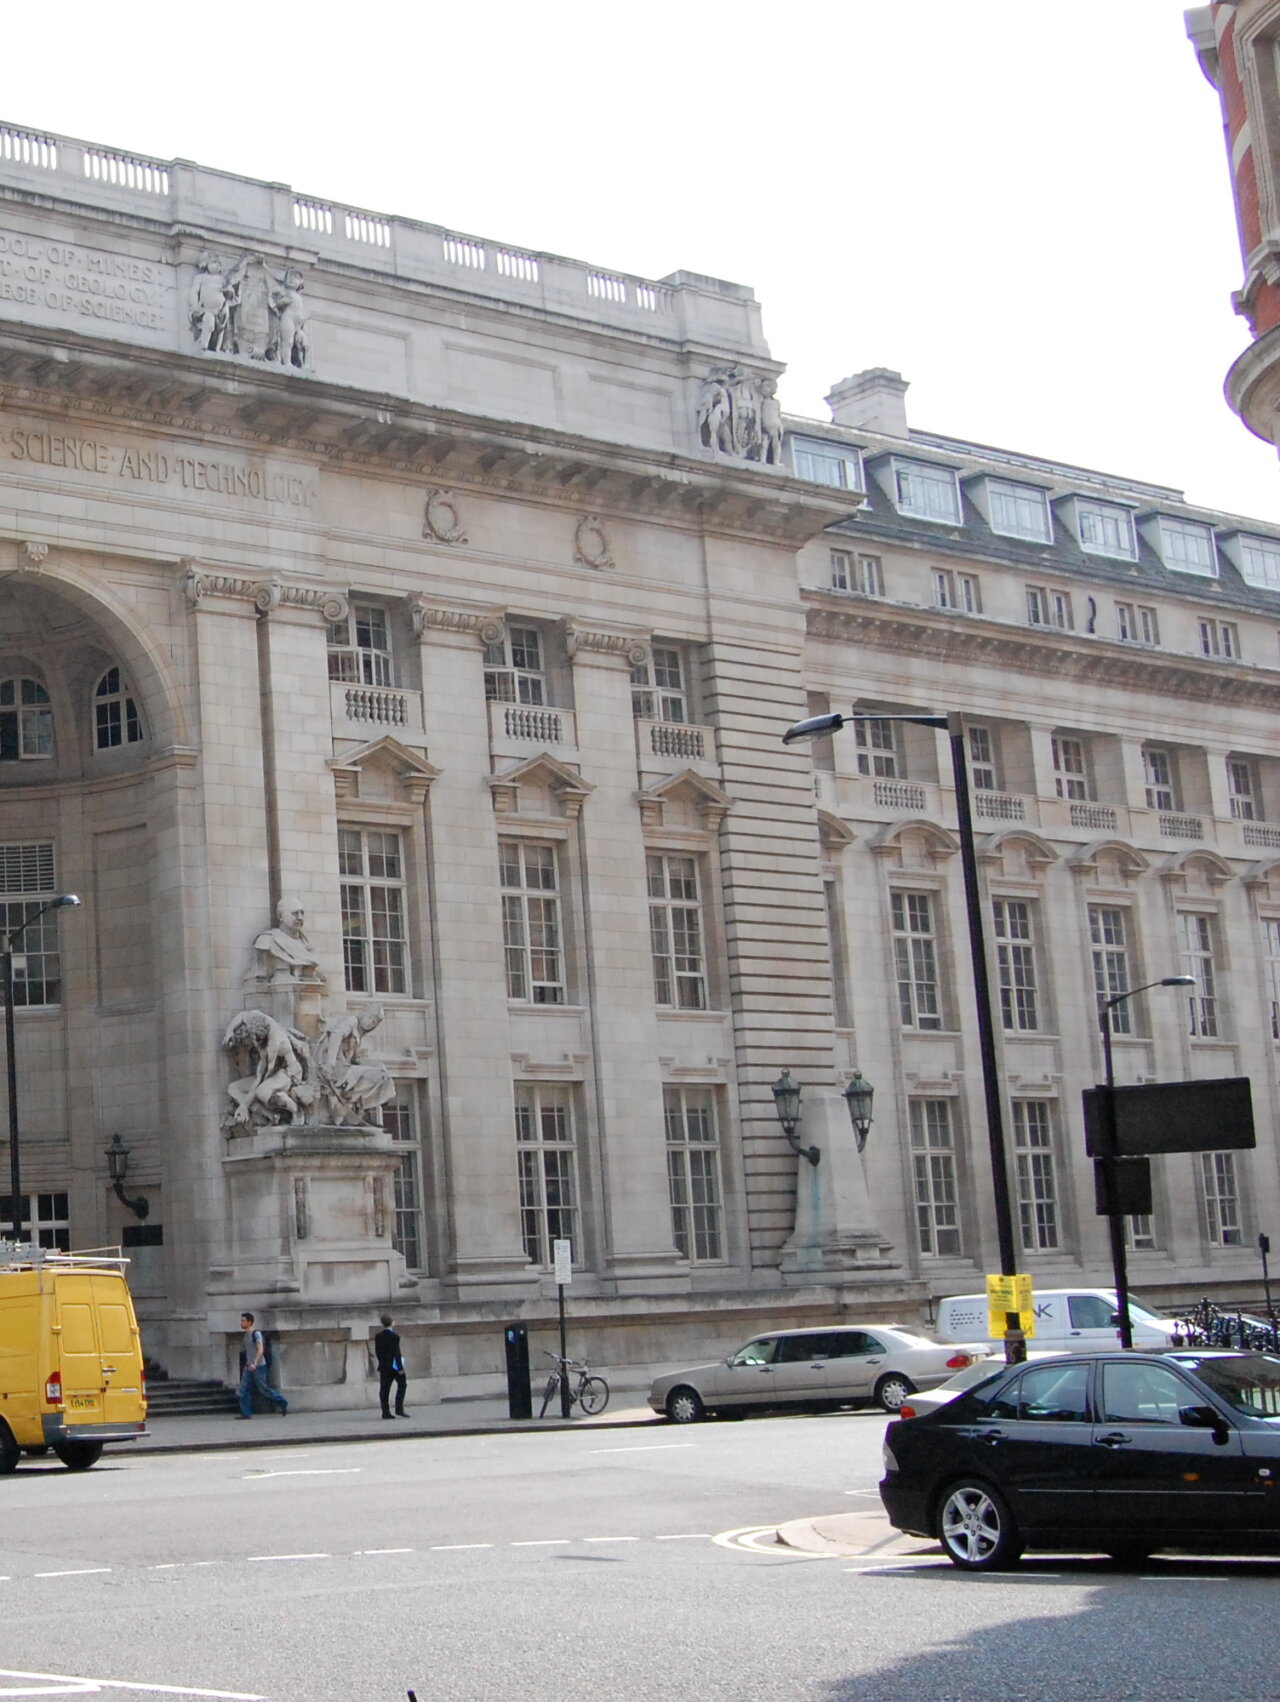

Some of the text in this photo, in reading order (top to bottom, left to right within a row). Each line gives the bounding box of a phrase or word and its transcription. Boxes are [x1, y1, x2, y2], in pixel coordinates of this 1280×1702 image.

[23, 265, 52, 285] OF
[63, 273, 157, 306] GEOLOGY
[46, 246, 75, 268] OF
[86, 254, 154, 285] MINES
[45, 292, 73, 312] OF
[79, 299, 158, 331] SCIENCE
[10, 429, 109, 474] SCIENCE
[118, 446, 169, 484] AND
[178, 457, 313, 508] TECHNOLOGY
